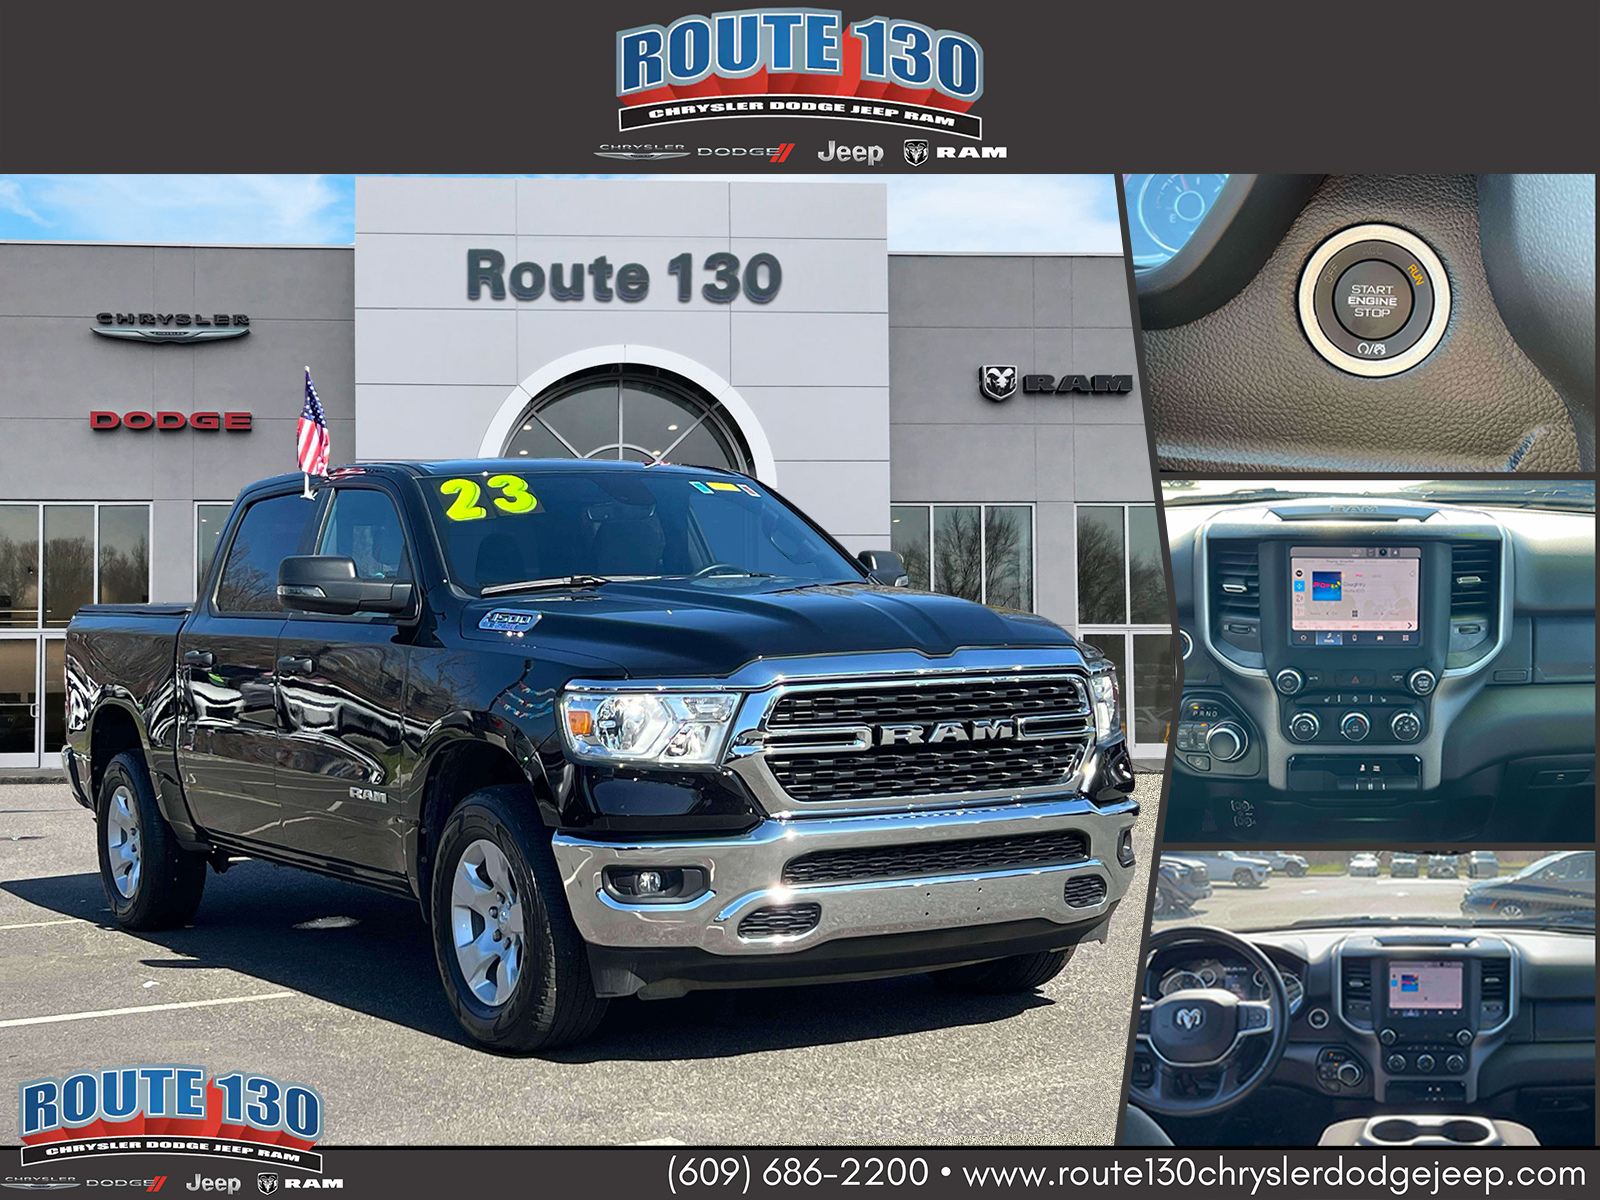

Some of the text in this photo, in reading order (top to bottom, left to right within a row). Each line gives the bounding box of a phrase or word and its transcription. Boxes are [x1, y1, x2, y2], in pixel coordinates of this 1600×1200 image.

[467, 248, 783, 304] Route 130
[1323, 263, 1338, 284] OFF
[1407, 263, 1425, 286] RUN
[1351, 284, 1395, 295] START
[1347, 296, 1398, 307] ENGINE
[96, 312, 250, 326] CHRYSLER
[1354, 308, 1391, 318] STOP
[1022, 374, 1133, 395] RAM
[90, 410, 252, 431] DODGE
[440, 474, 538, 522] 23
[492, 612, 532, 624] 1500
[880, 718, 1014, 746] RAM
[349, 786, 388, 804] RAM
